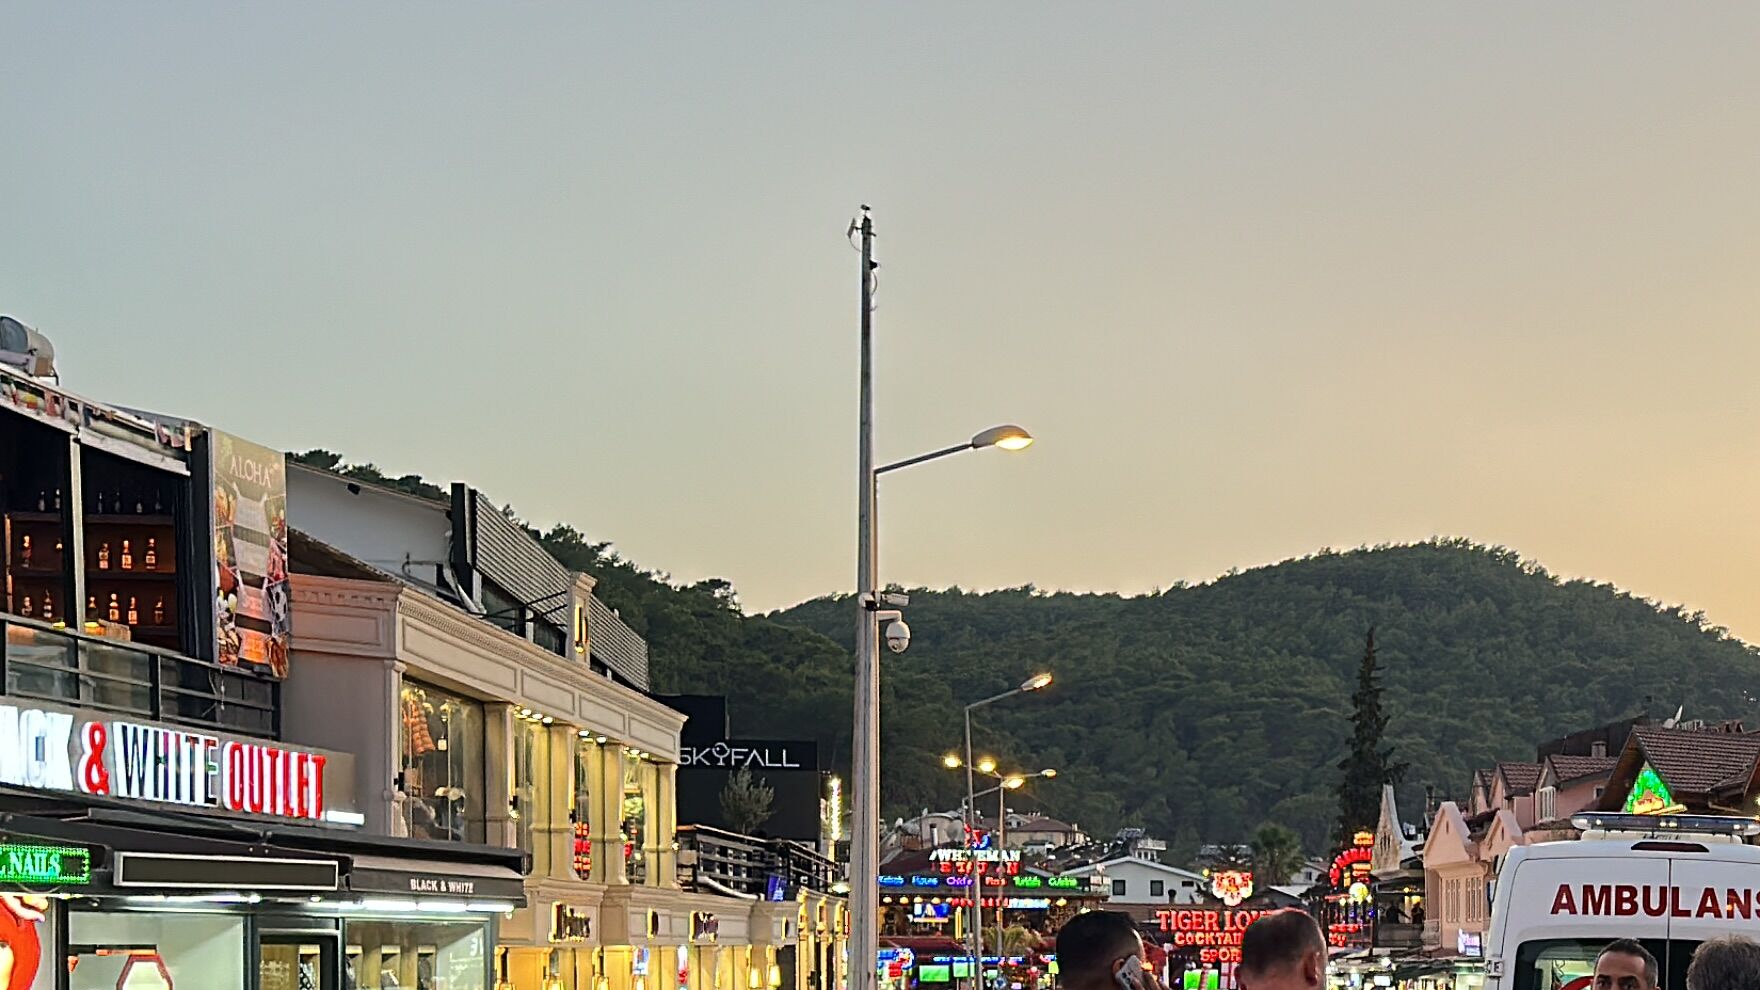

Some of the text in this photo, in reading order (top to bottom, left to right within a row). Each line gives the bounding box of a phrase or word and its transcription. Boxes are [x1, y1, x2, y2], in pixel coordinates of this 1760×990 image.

[229, 455, 272, 488] ALOHA
[679, 742, 800, 768] SKYFALL
[77, 721, 110, 795] &
[112, 721, 219, 808] WHITE
[222, 740, 327, 820] OUTLET
[10, 851, 61, 878] NAILS
[410, 878, 474, 894] BLACK & WHITE
[1155, 909, 1220, 933] TIGER
